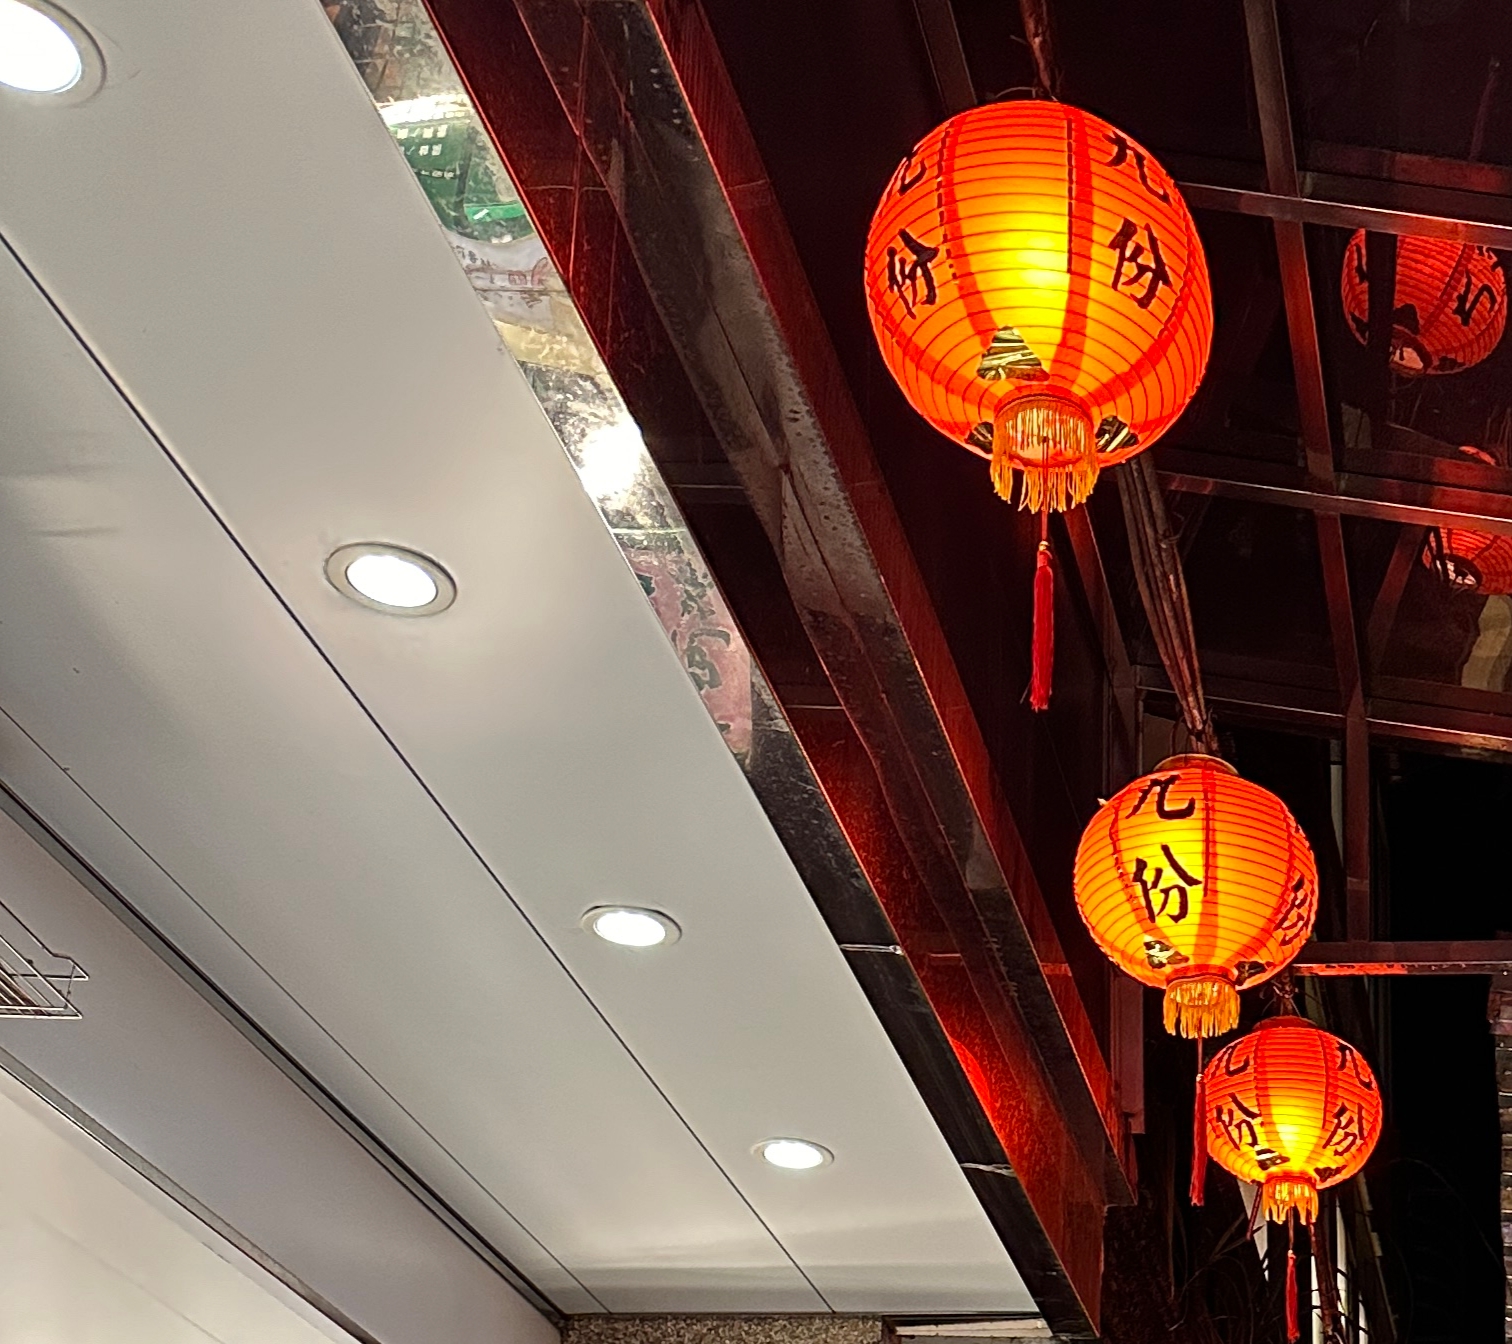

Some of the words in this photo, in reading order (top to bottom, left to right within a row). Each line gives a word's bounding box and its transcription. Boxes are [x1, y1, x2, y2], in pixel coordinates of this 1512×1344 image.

[1103, 130, 1173, 310] 九份
[1124, 774, 1203, 924] 九份
[1210, 1040, 1264, 1151] 九份
[1322, 1043, 1374, 1157] 九份
